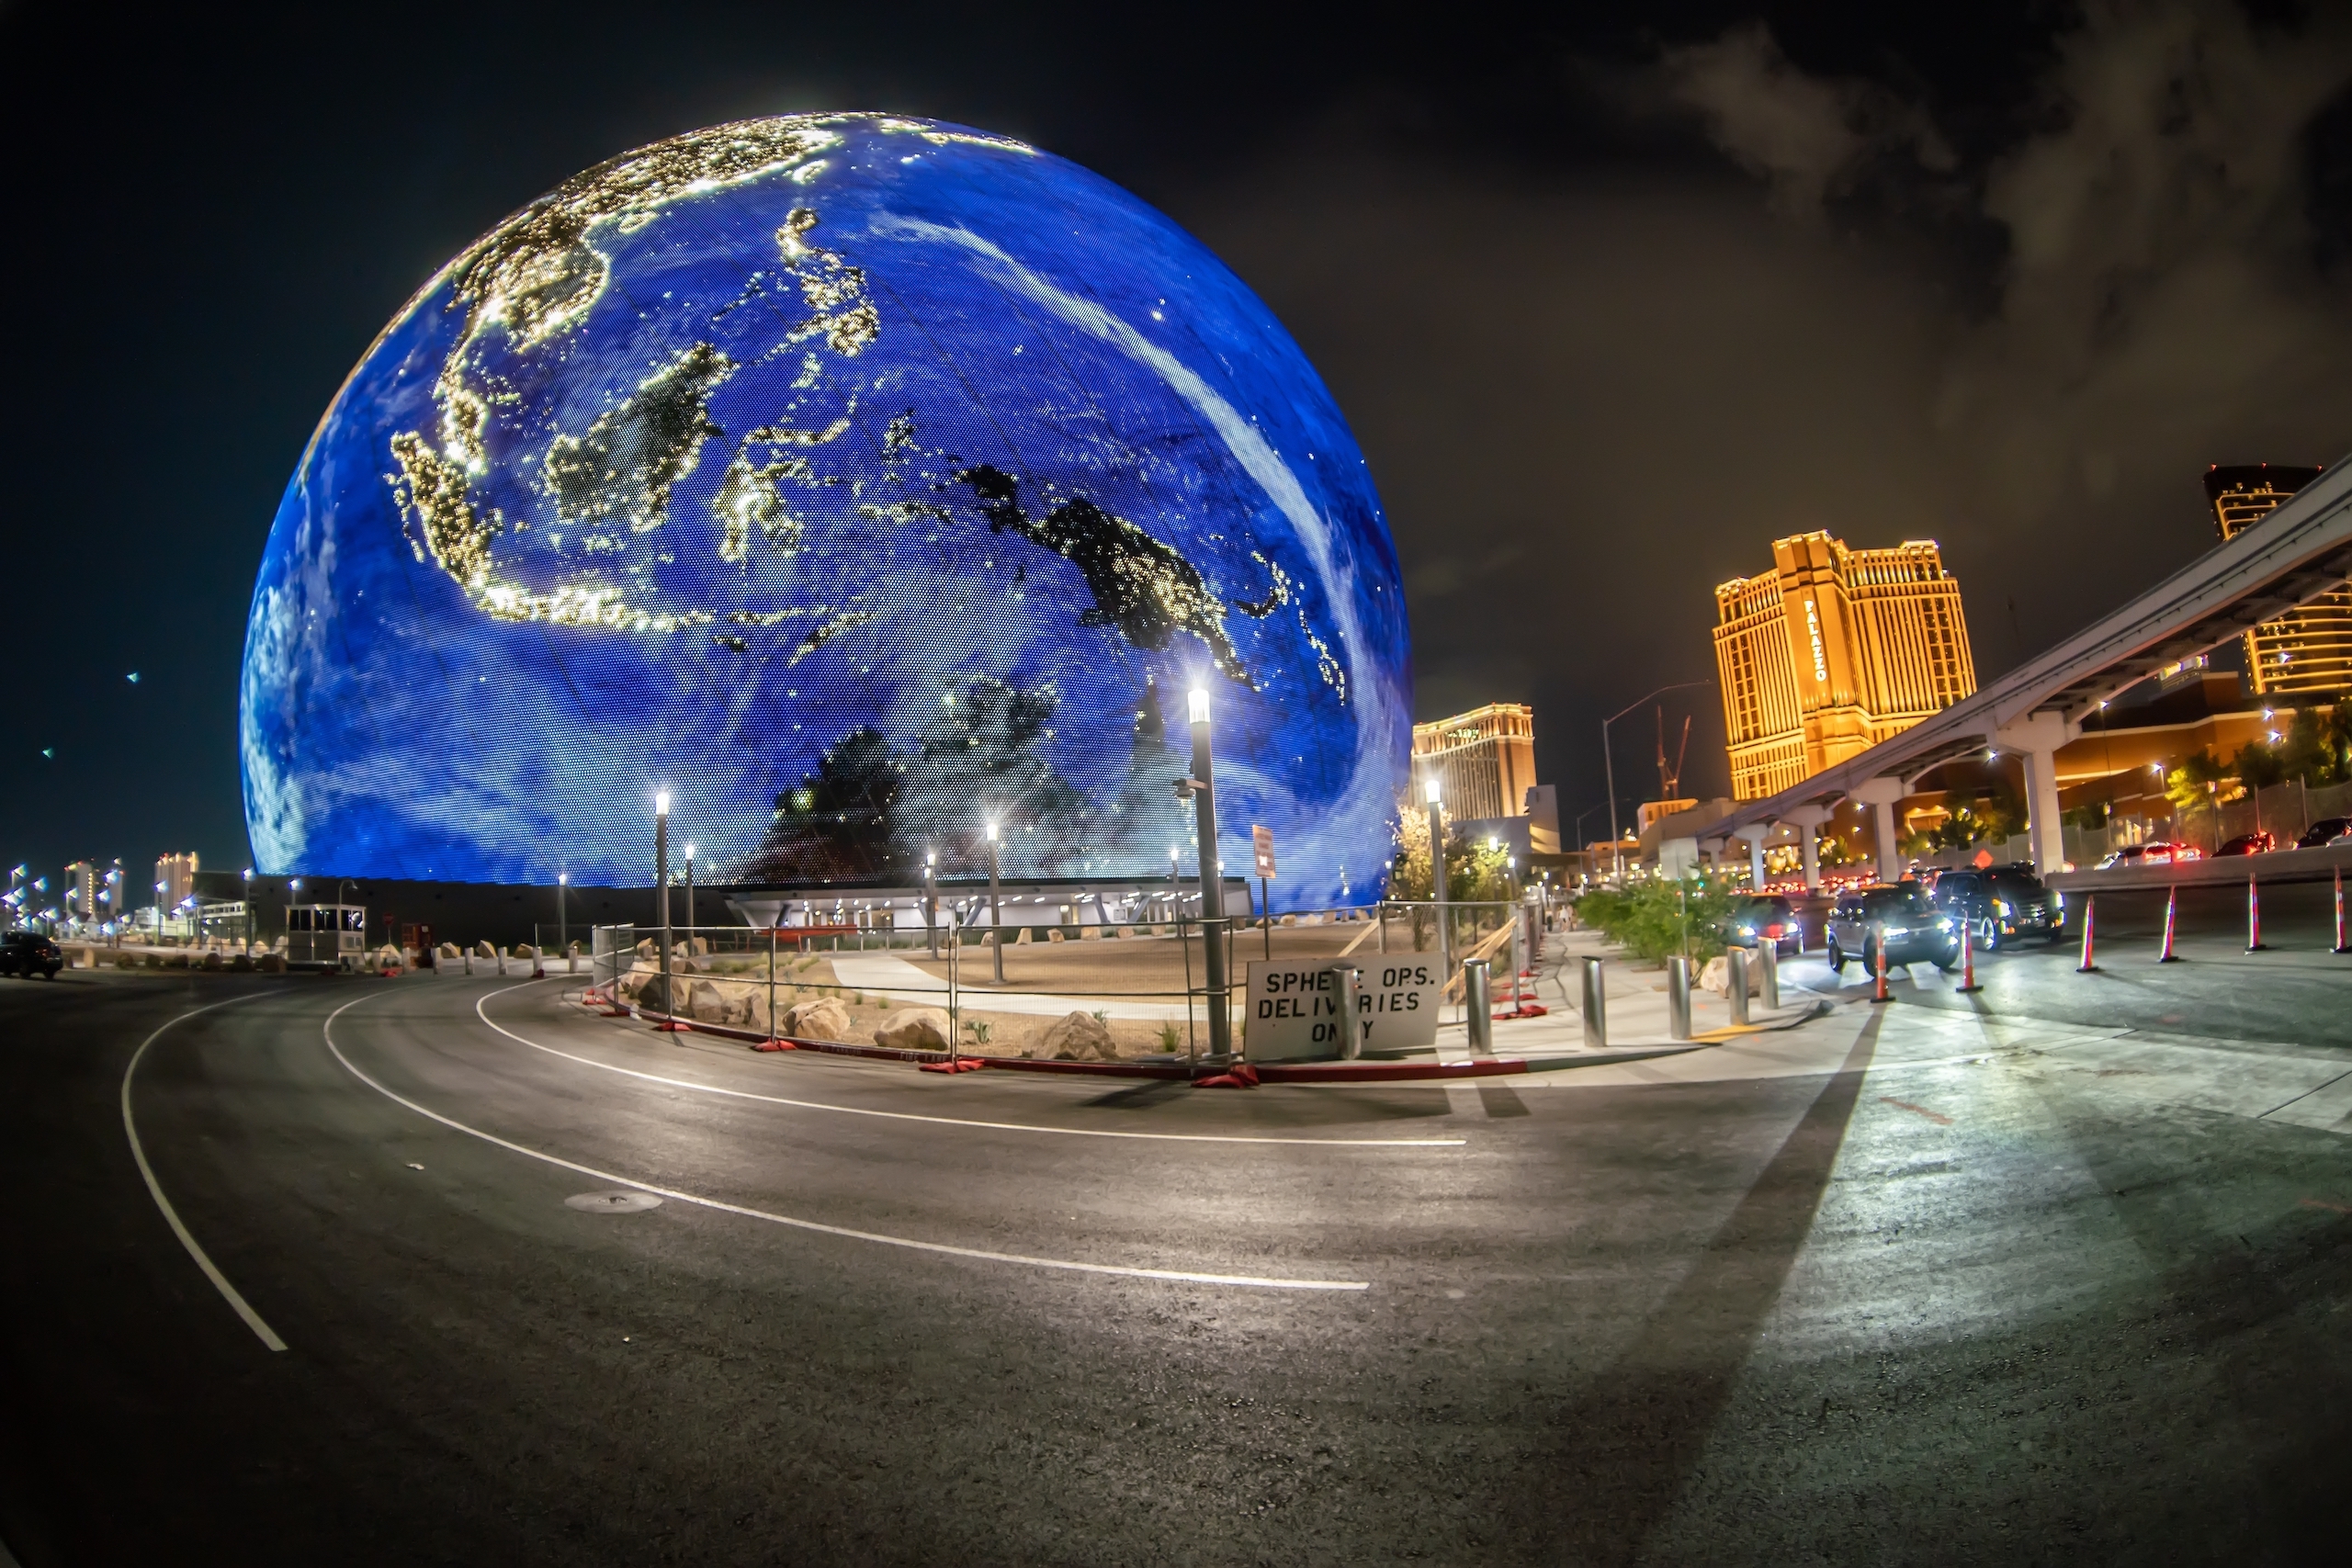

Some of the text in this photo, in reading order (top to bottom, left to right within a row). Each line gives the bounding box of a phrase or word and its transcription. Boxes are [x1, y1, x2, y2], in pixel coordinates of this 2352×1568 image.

[1804, 600, 1826, 682] PALAZZO
[1383, 967, 1435, 987] OPS.
[1259, 992, 1419, 1019] DELIVRIES
[1312, 1021, 1374, 1042] ONY
[899, 1052, 947, 1063] FIRE LANE
